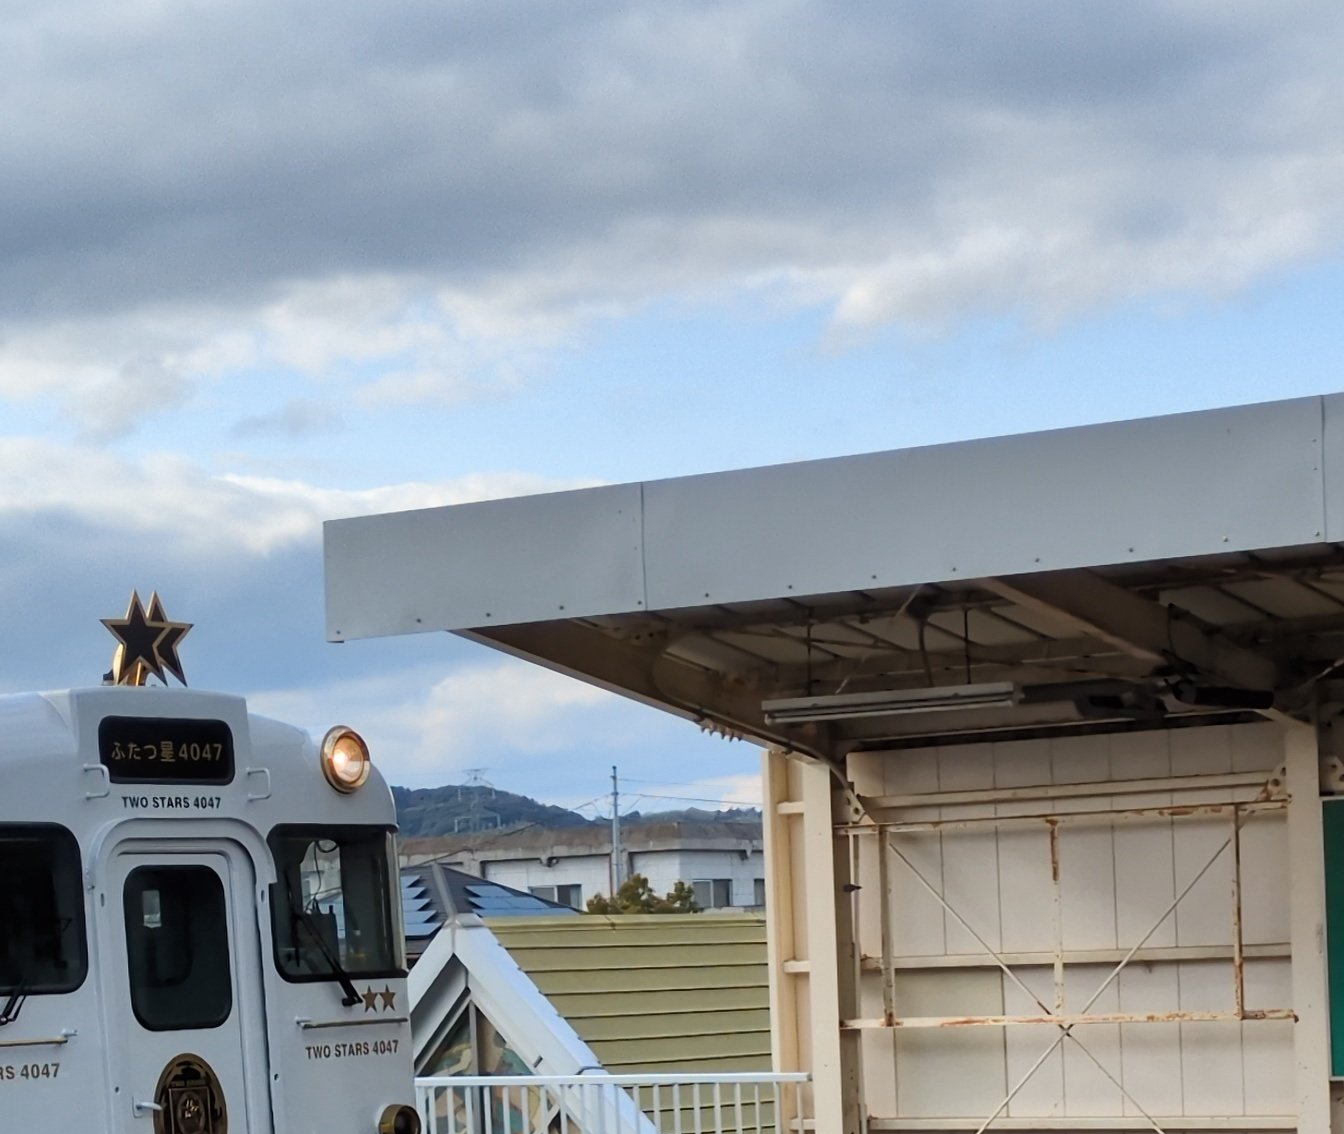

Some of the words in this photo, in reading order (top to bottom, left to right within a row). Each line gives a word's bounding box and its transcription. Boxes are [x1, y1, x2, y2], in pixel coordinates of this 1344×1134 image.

[111, 741, 223, 762] ふたつ星4047
[121, 796, 149, 809] TWO
[152, 796, 190, 809] STARS
[193, 796, 221, 809] 4047
[305, 1045, 331, 1060] TWO
[334, 1042, 370, 1058] STARS
[372, 1039, 399, 1055] 4047
[20, 1062, 61, 1080] 4047
